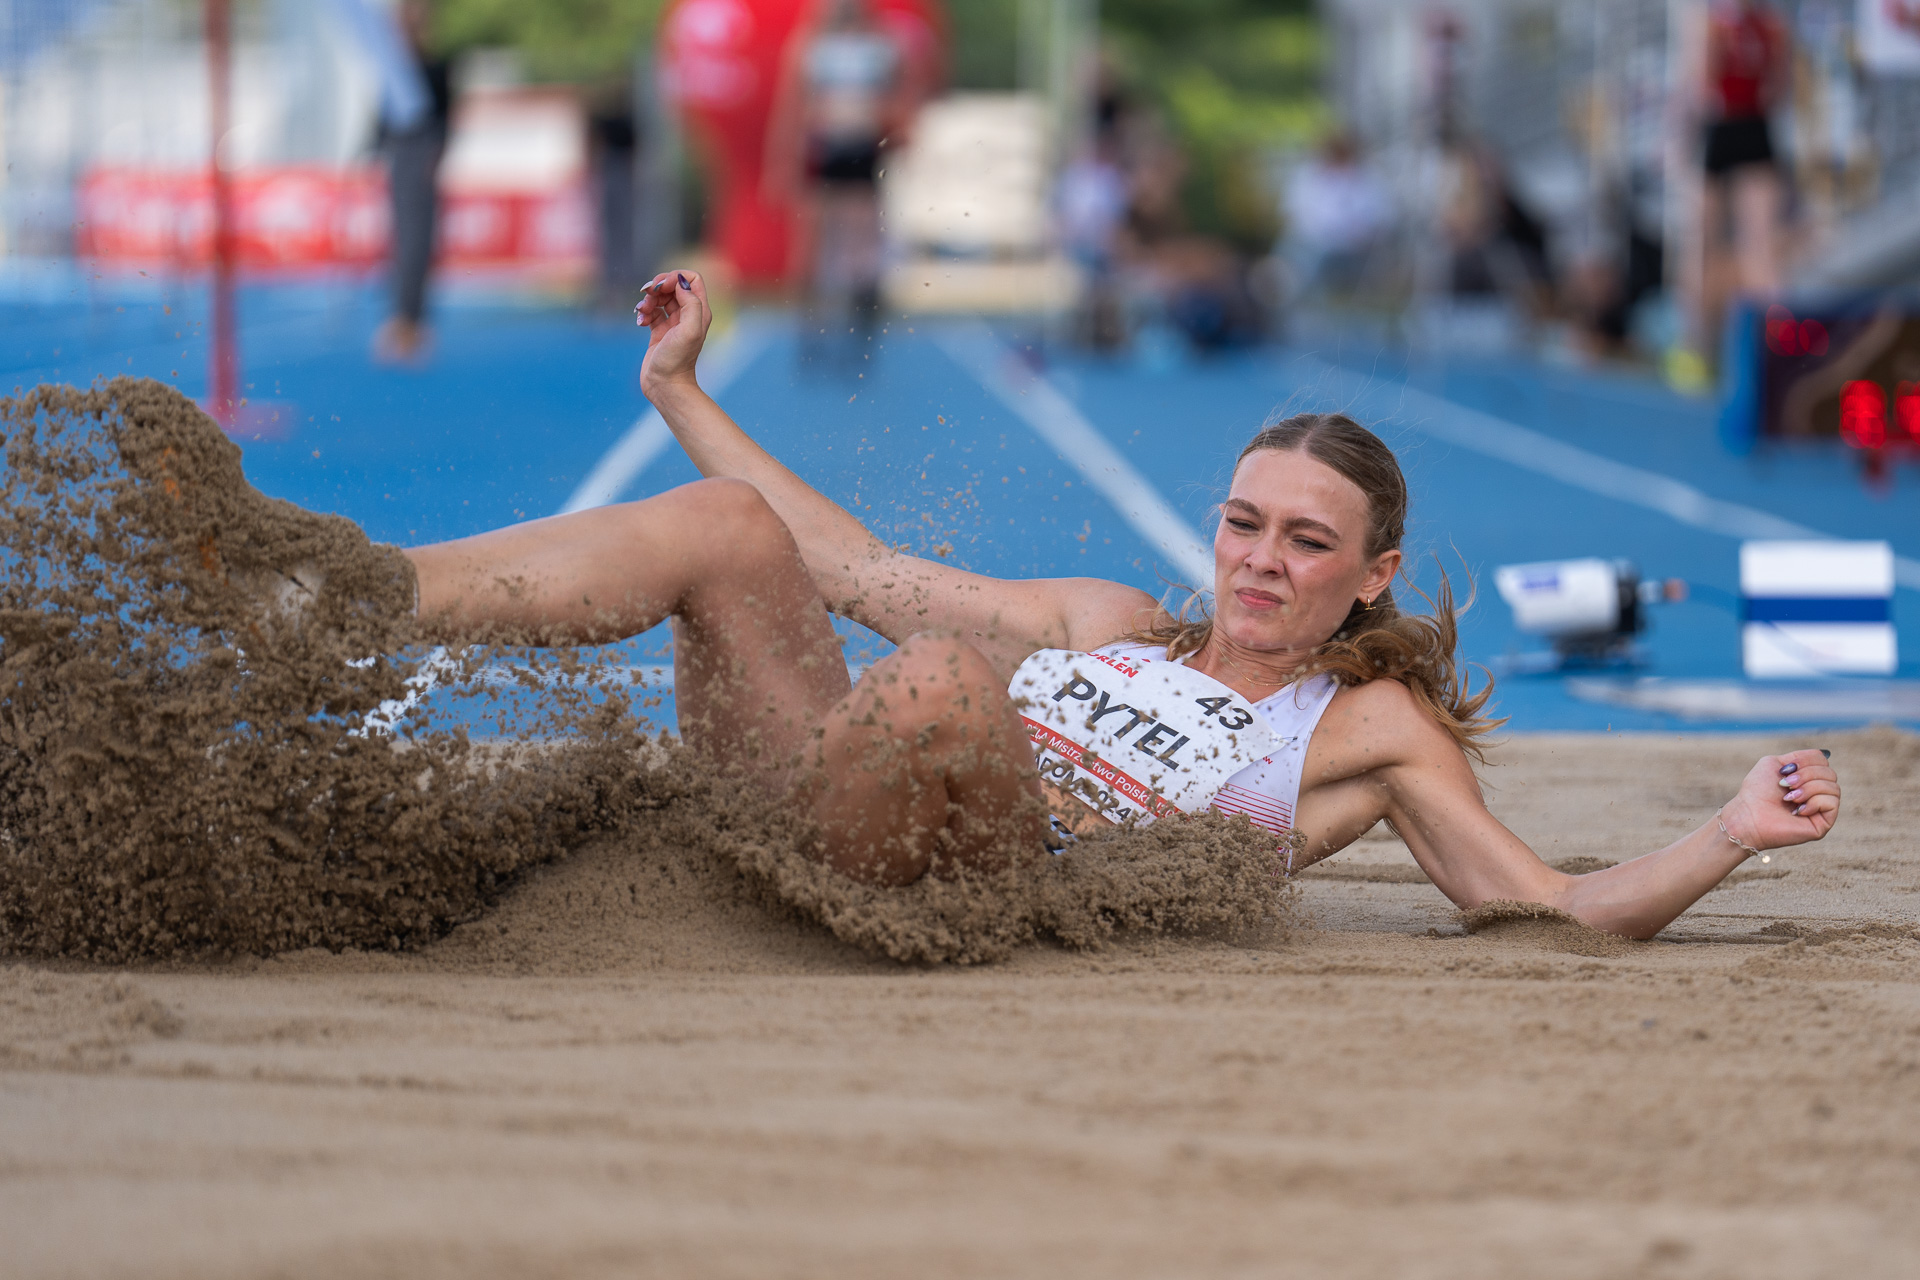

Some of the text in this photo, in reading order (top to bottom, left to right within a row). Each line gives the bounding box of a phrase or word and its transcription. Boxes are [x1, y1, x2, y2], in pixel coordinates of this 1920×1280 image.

[1051, 674, 1191, 771] PYTEL
[1195, 697, 1254, 731] 43
[1048, 736, 1116, 781] Mistrztwa
[1082, 781, 1132, 822] 024
